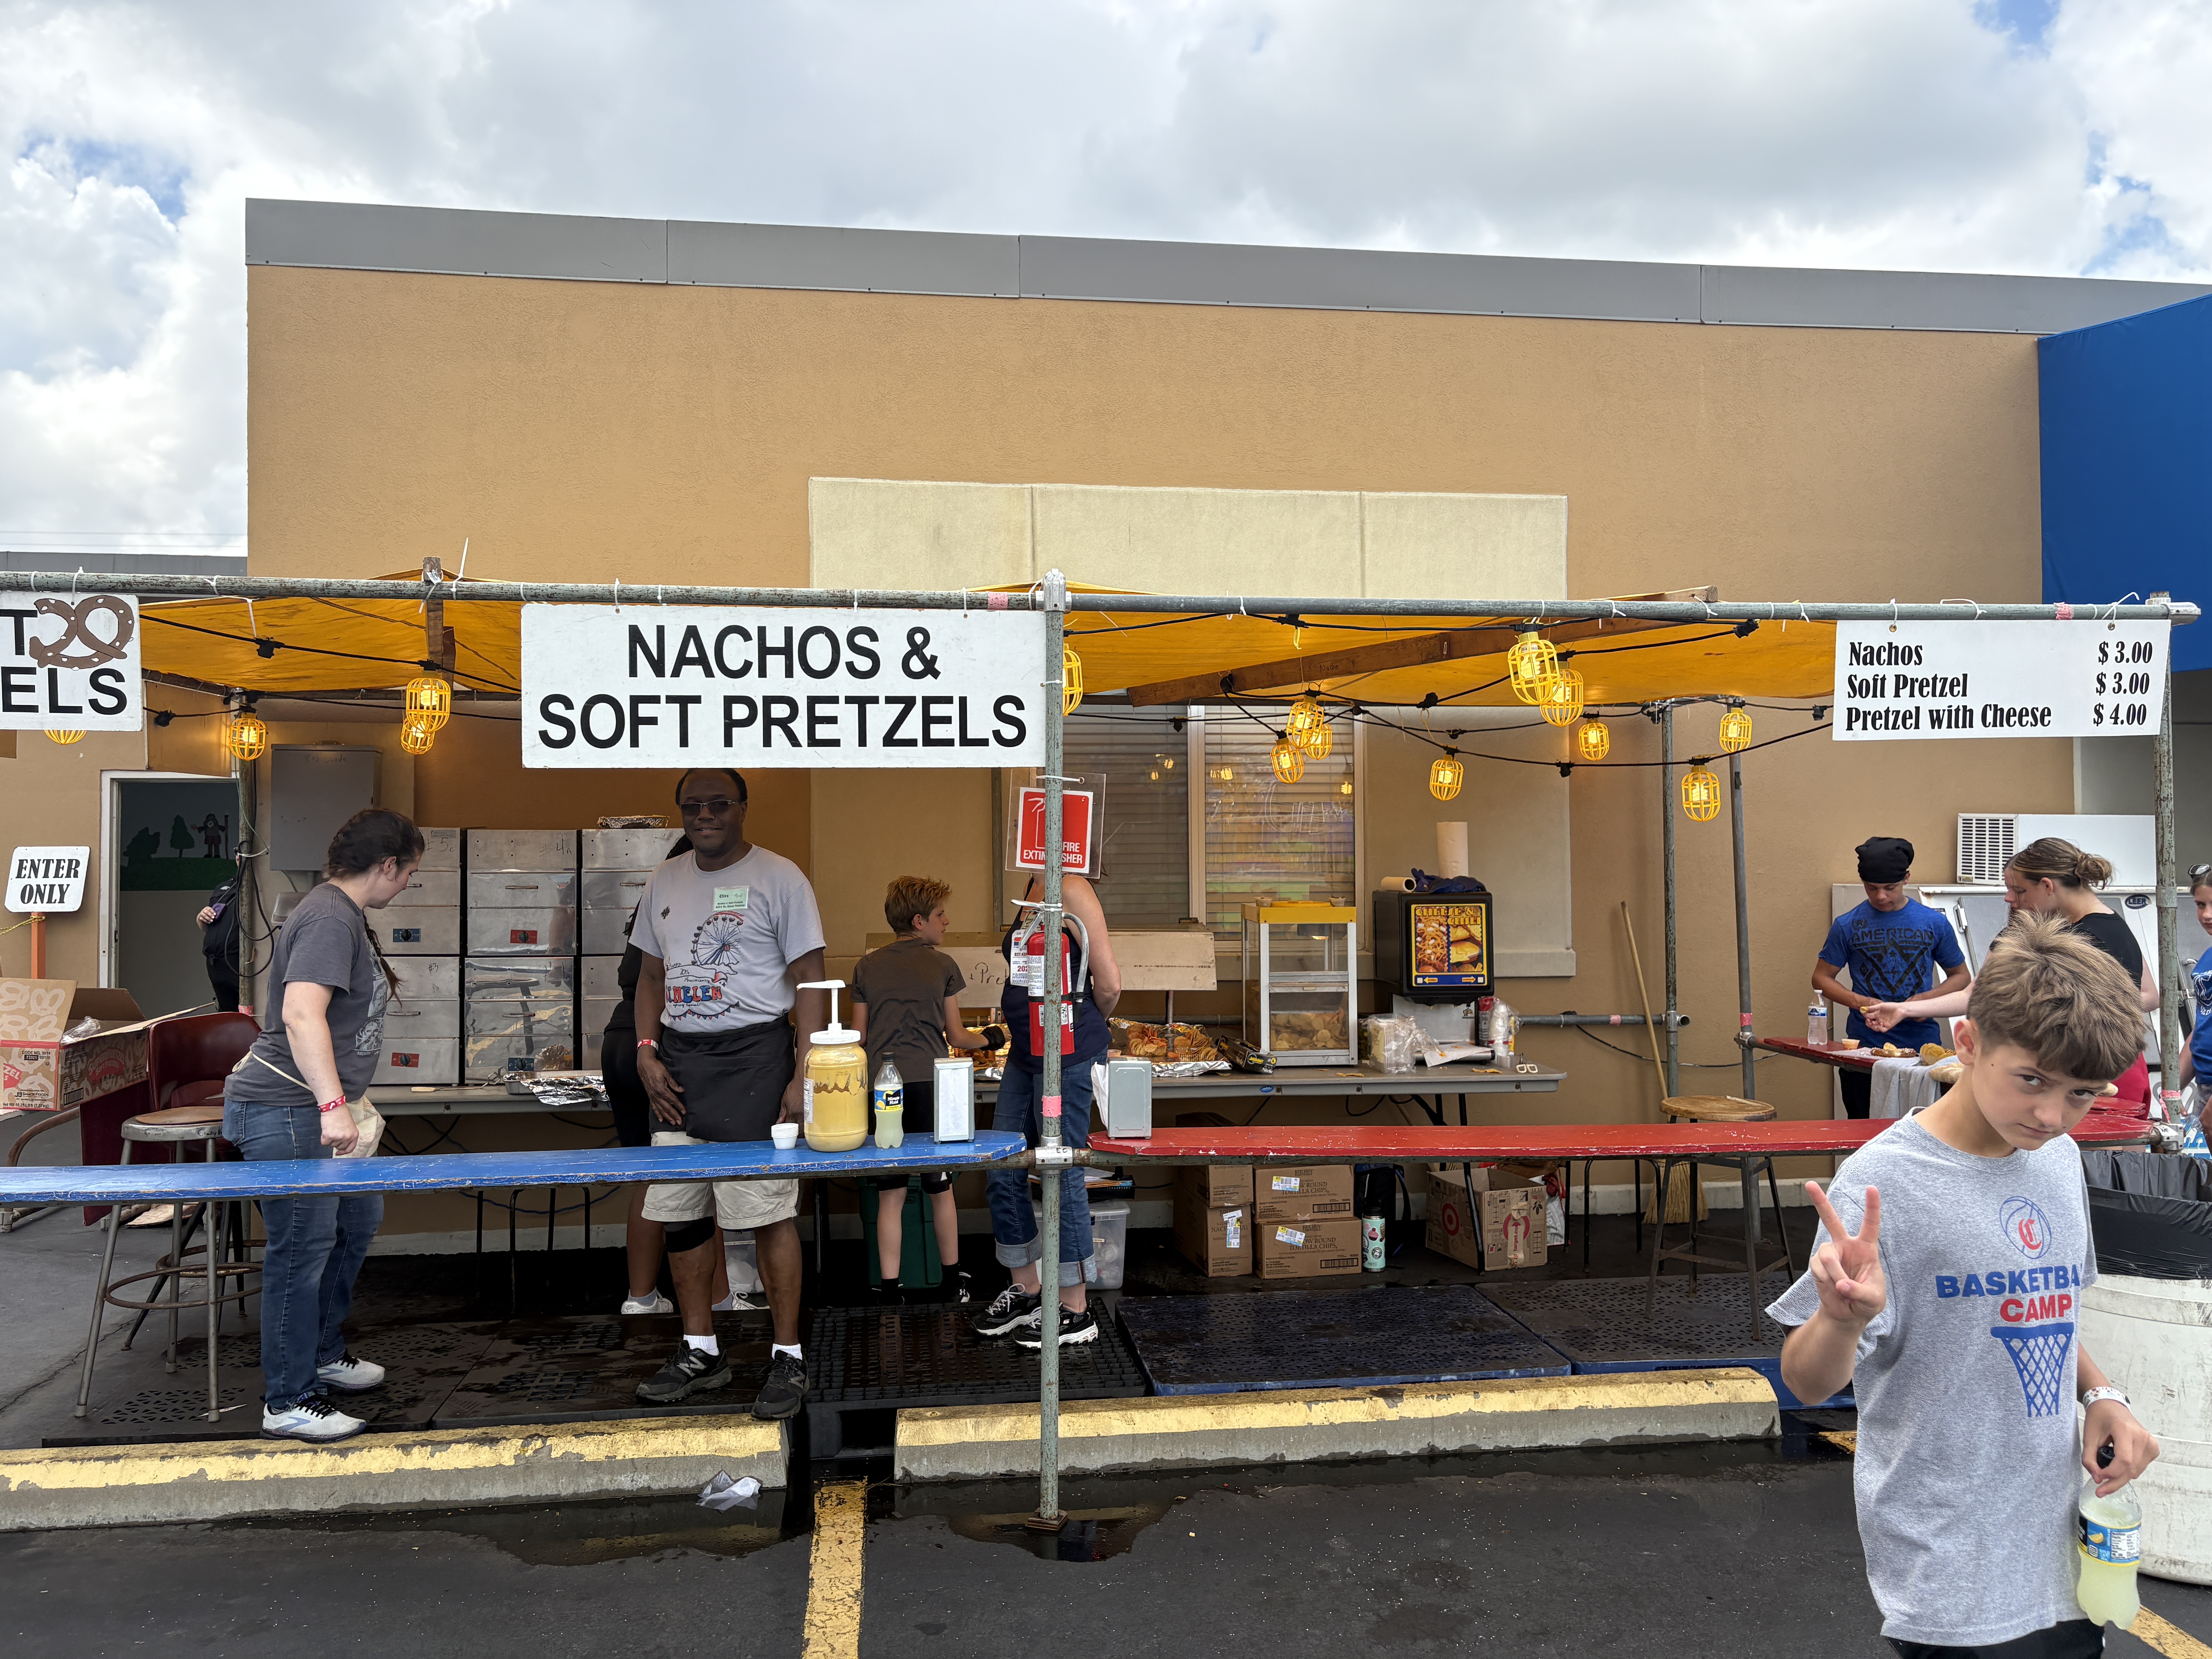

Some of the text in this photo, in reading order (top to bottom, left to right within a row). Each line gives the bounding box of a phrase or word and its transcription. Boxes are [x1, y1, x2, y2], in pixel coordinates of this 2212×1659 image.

[629, 625, 941, 680] NACHOS &
[1849, 642, 1923, 666] Nachos
[2115, 641, 2152, 663] 3.00
[1, 666, 127, 716] ELS
[1848, 674, 1887, 699] Soft
[1893, 673, 1968, 698] Pretzel
[2112, 672, 2150, 694] 3.00
[538, 694, 1026, 749] SOFT PRETZELS
[1846, 706, 1920, 731] Pretzel
[1928, 705, 1974, 729] with
[1981, 704, 2051, 728] Cheese
[2109, 703, 2147, 726] 4.00
[1023, 849, 1083, 864] EXTINSHER
[1063, 842, 1080, 852] FIRE
[15, 859, 81, 879] ENTER
[20, 884, 70, 904] ONLY
[1415, 907, 1475, 917] CHEESE &
[1447, 917, 1481, 925] CHILI
[1851, 926, 1934, 945] AMERICAN
[673, 985, 722, 1003] HELEN
[3, 1065, 20, 1080] ZEL
[1936, 1263, 2081, 1298] BASKETBA
[1999, 1293, 2072, 1322] CAMP
